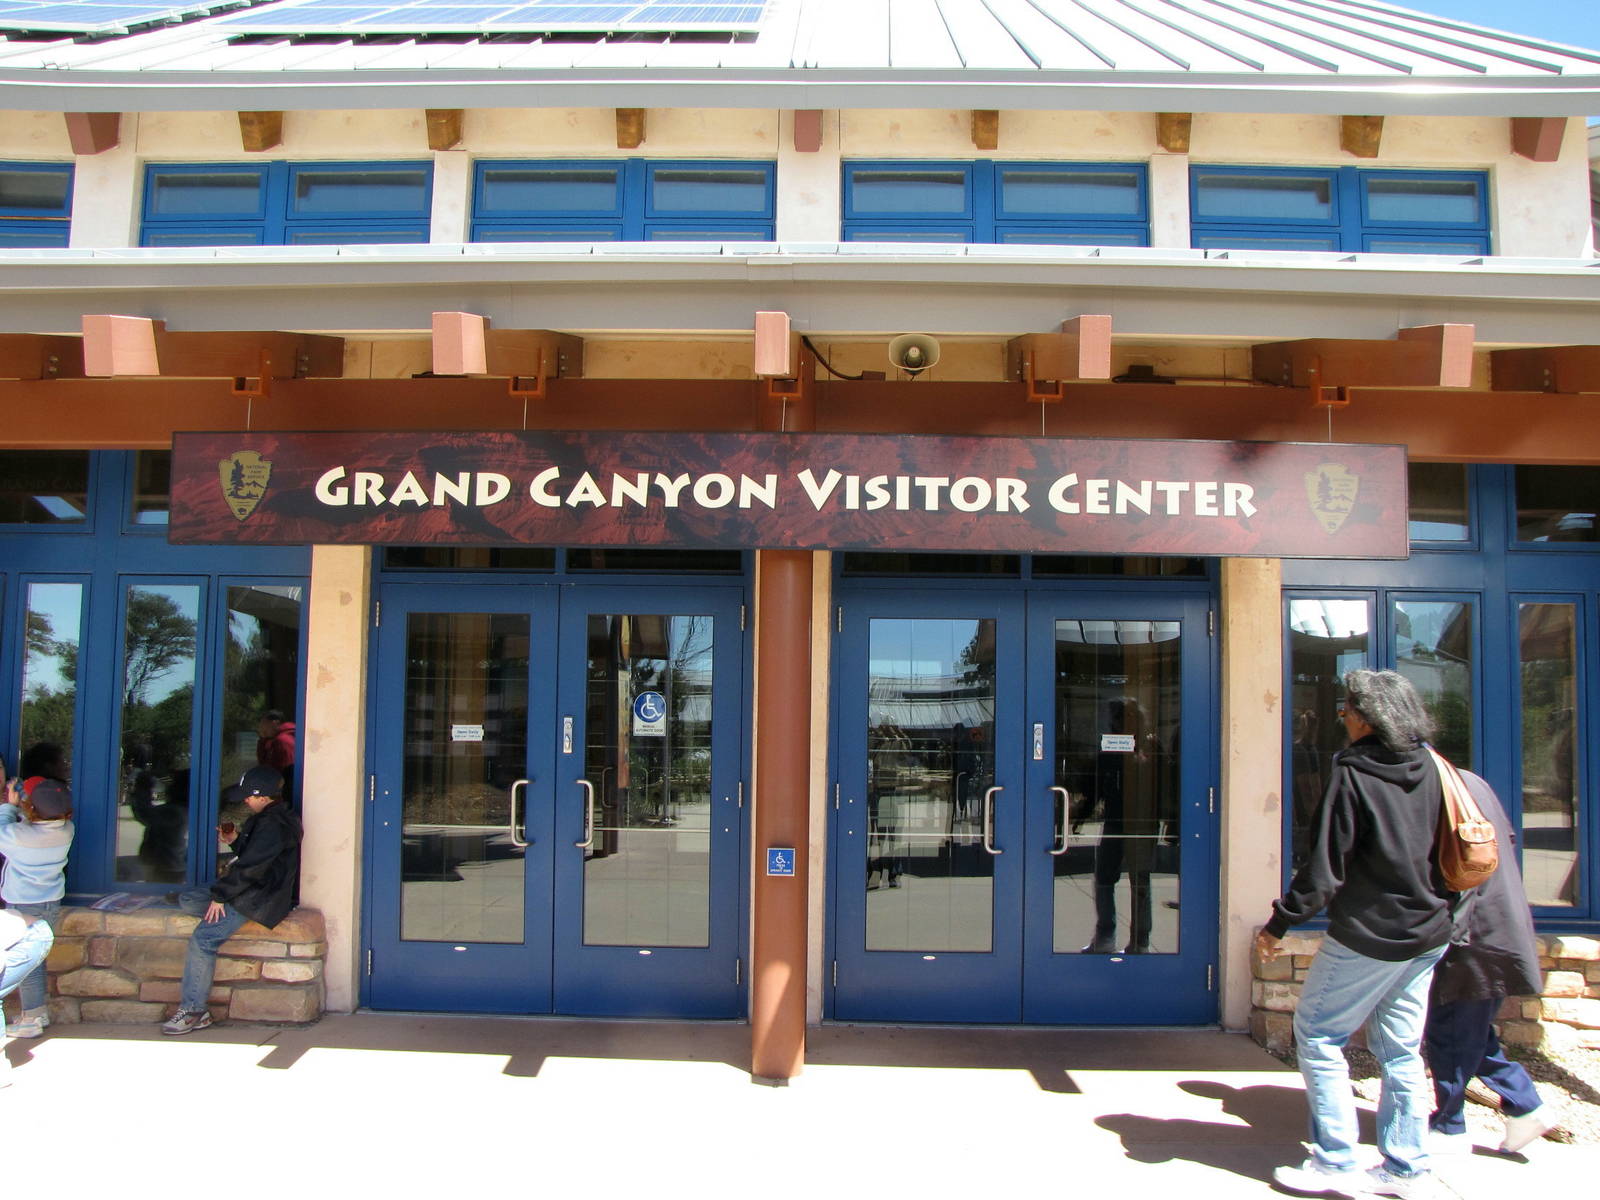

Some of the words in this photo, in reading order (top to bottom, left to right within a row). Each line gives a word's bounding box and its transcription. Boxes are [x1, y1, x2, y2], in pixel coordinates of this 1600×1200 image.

[315, 465, 511, 507] GRAND
[529, 466, 778, 509] CANYON
[797, 468, 1031, 513] VISITOR
[1048, 472, 1258, 518] CENTER
